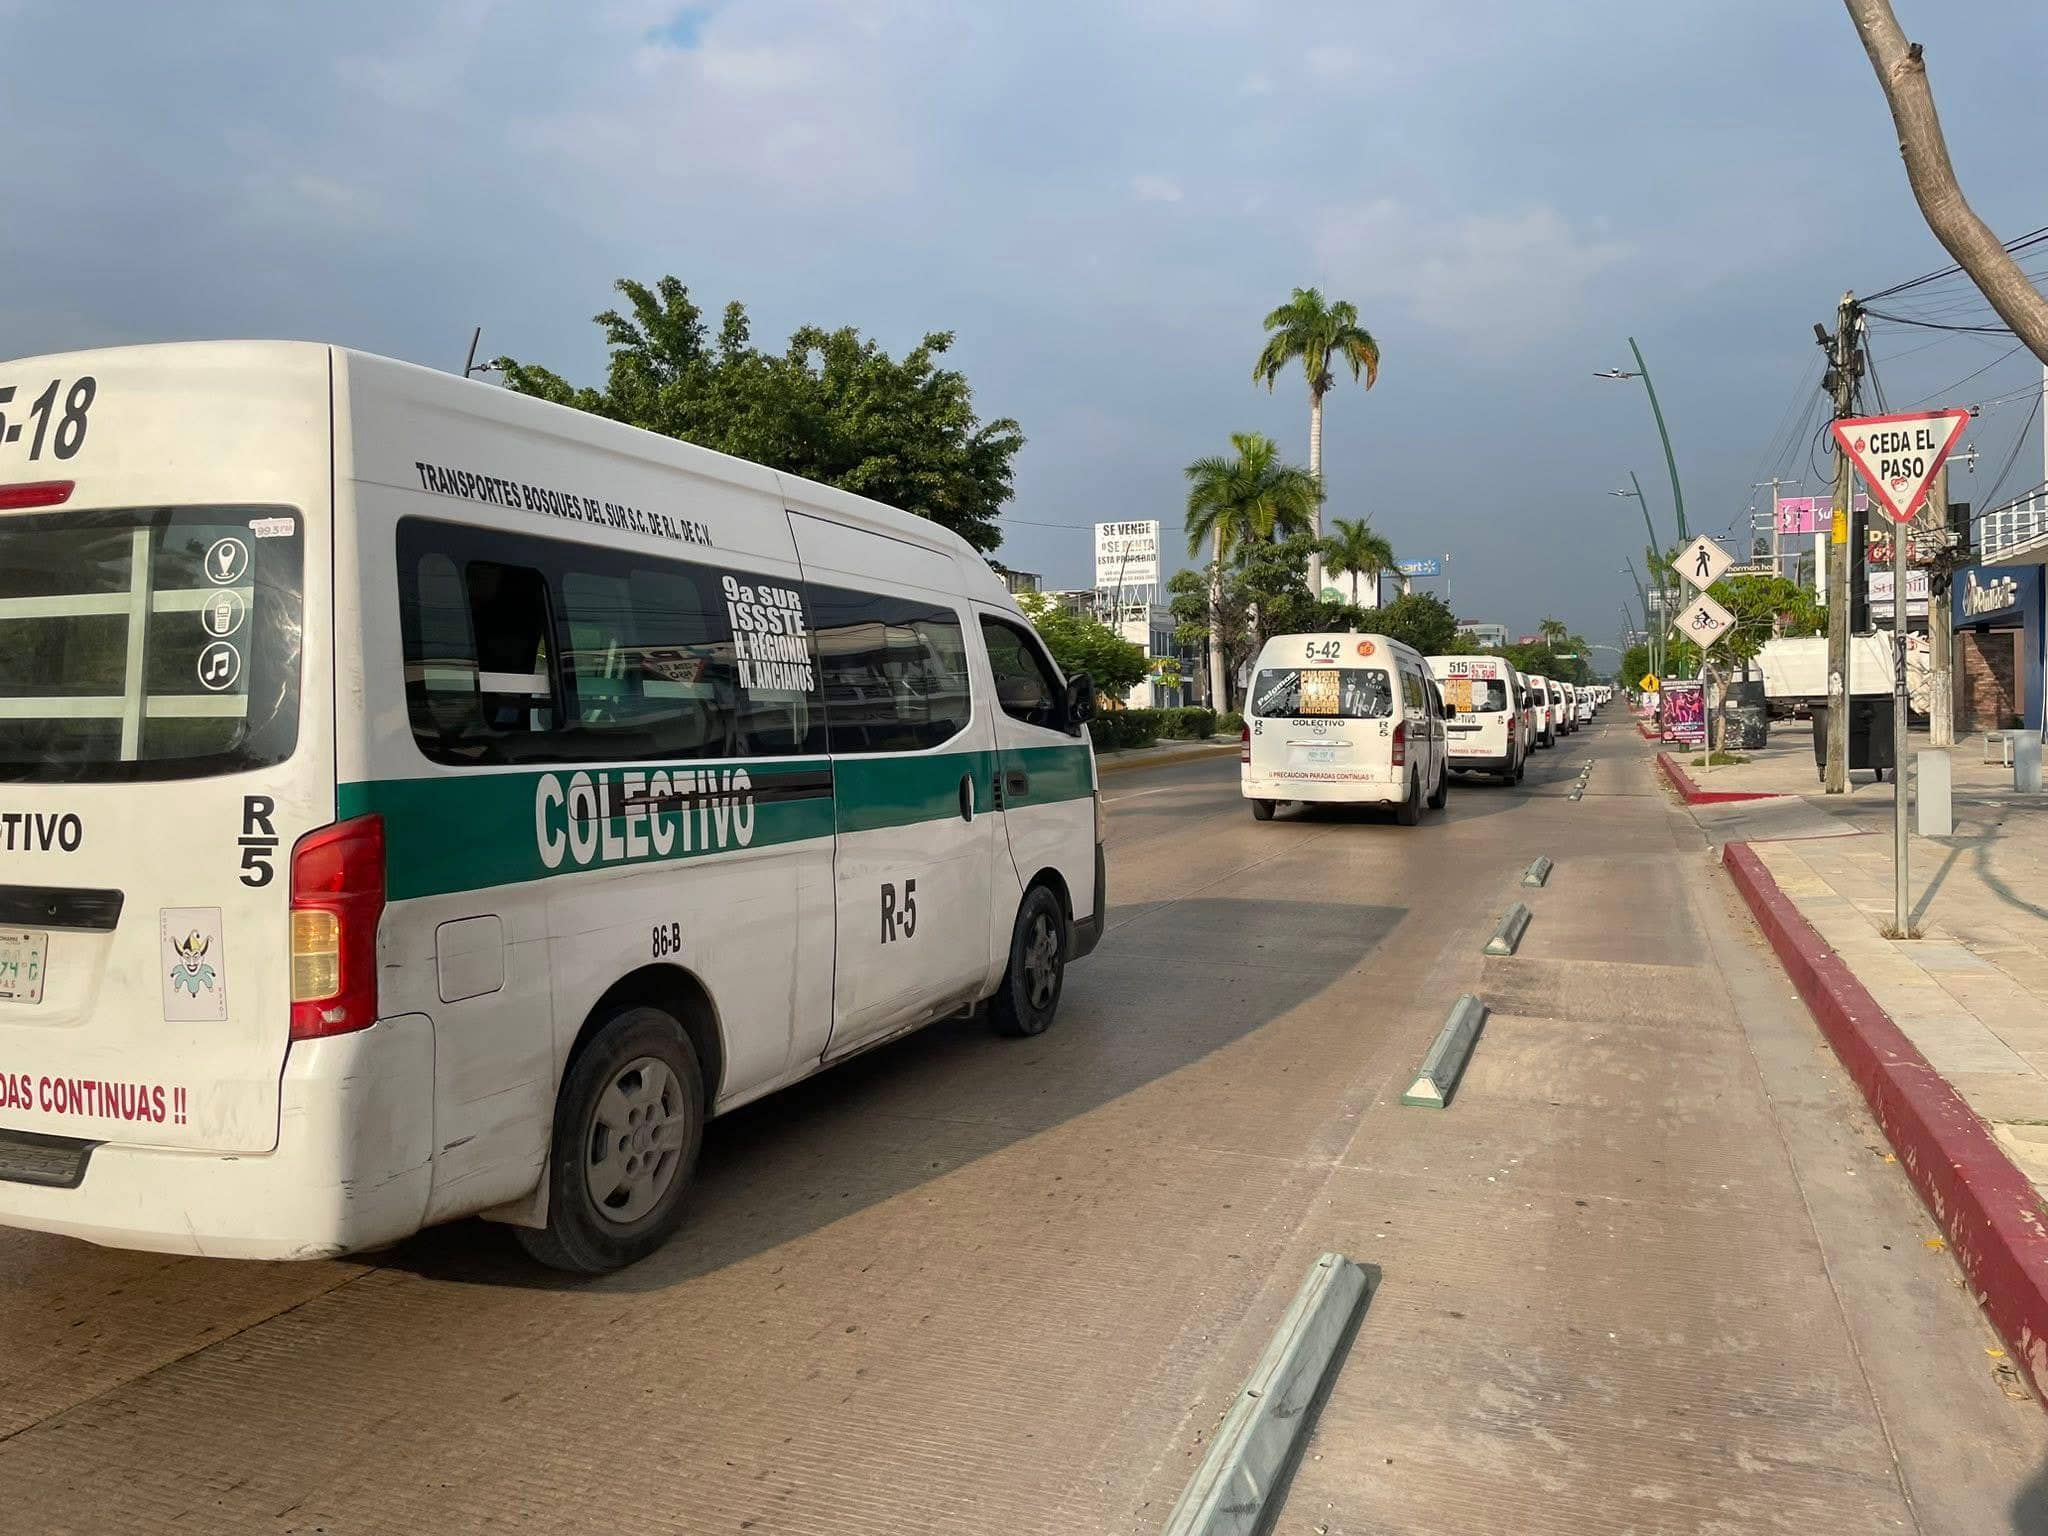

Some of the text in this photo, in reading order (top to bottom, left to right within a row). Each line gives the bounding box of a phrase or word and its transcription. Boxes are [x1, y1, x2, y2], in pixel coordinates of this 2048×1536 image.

[1870, 429, 1935, 454] CEDA EL
[1881, 457, 1924, 480] PASO
[415, 462, 522, 508] TRANSPORTES
[522, 484, 583, 519] BOSQUES
[583, 497, 606, 525] DEL
[605, 502, 629, 529] SUR
[647, 512, 664, 536] DE
[680, 519, 696, 543] DE
[1103, 523, 1151, 537] SE VENDE
[1097, 556, 1115, 566] ESTA
[1107, 540, 1120, 553] SE
[722, 575, 802, 610] 9a SUR
[727, 600, 807, 636] ISSSTE
[733, 631, 749, 659] H.
[1305, 641, 1341, 660] 5-42
[738, 660, 815, 692] M. ANCIANOS
[1449, 662, 1468, 673] 515
[1292, 719, 1345, 728] COLECTIVO
[1309, 771, 1336, 780] PARADAS
[1336, 772, 1370, 781] CONTINUAS
[243, 795, 276, 835] R
[535, 767, 755, 868] COLECTIVO
[0, 813, 82, 852] TIVO
[239, 847, 274, 887] 5
[881, 879, 917, 944] R-5
[652, 922, 681, 958] 86-B
[39, 1076, 166, 1123] CONTINUAS
